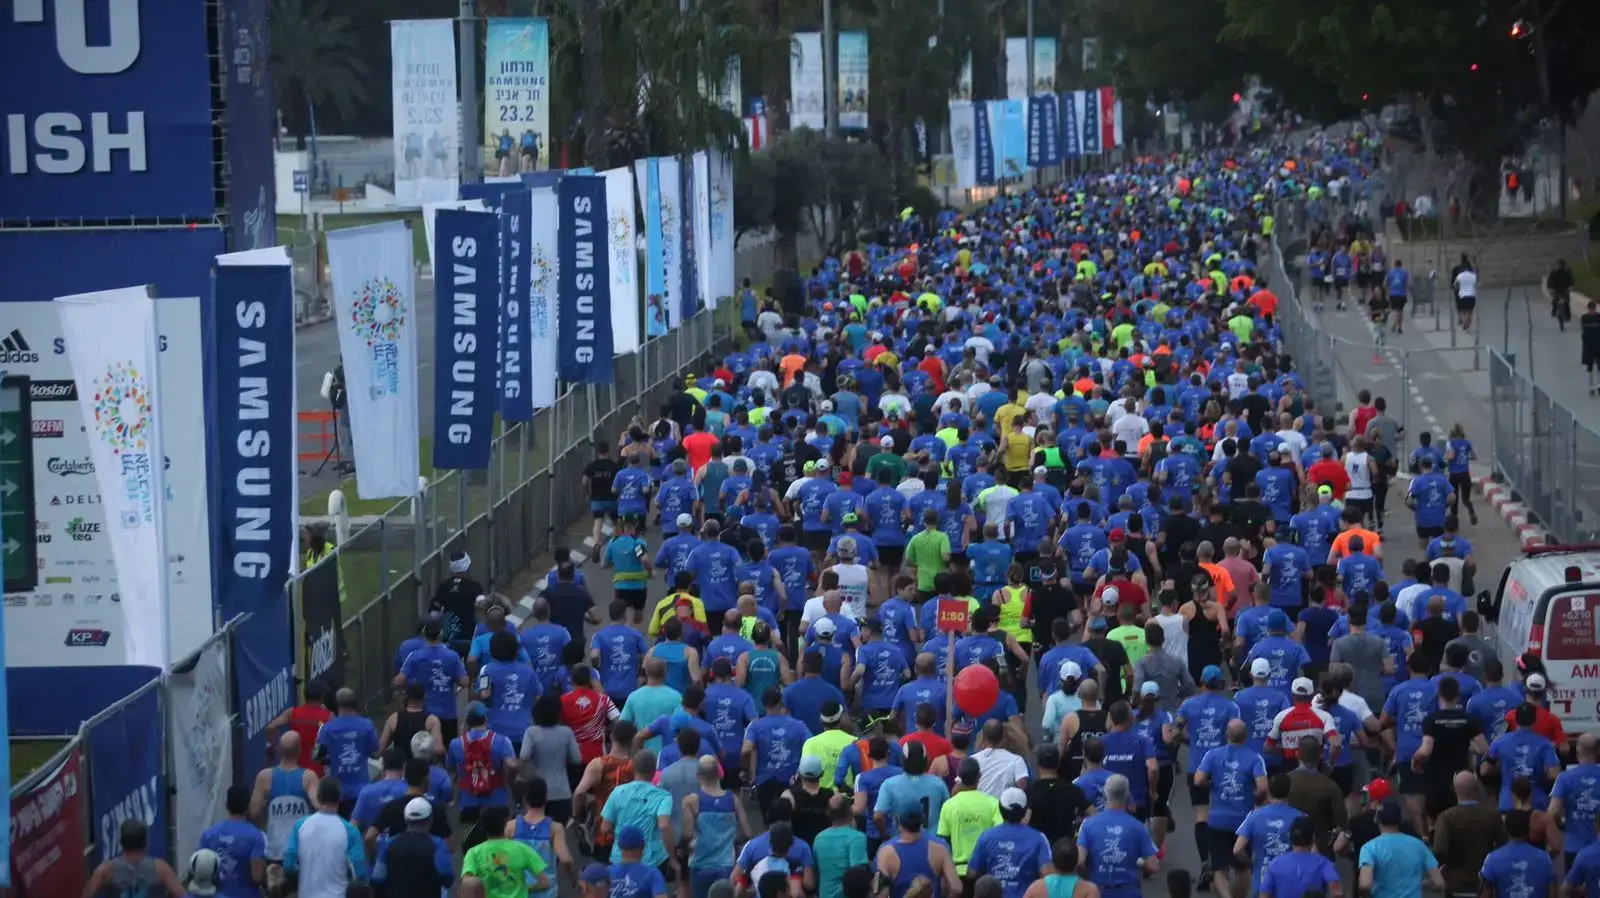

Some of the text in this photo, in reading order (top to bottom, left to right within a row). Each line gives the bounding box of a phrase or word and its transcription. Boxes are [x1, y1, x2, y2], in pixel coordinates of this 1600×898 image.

[500, 60, 534, 74] מרתון
[489, 76, 545, 86] SAMSUNG
[500, 105, 535, 122] 23.2
[7, 111, 147, 174] ISH
[573, 196, 595, 364] SAMSUNG
[447, 235, 477, 445] SAMSUNG
[233, 300, 272, 579] SAMSUNG
[47, 457, 95, 476] Carlsberg
[73, 523, 100, 533] FUZE
[940, 611, 965, 621] 1:50
[246, 667, 289, 740] SAMSUNG
